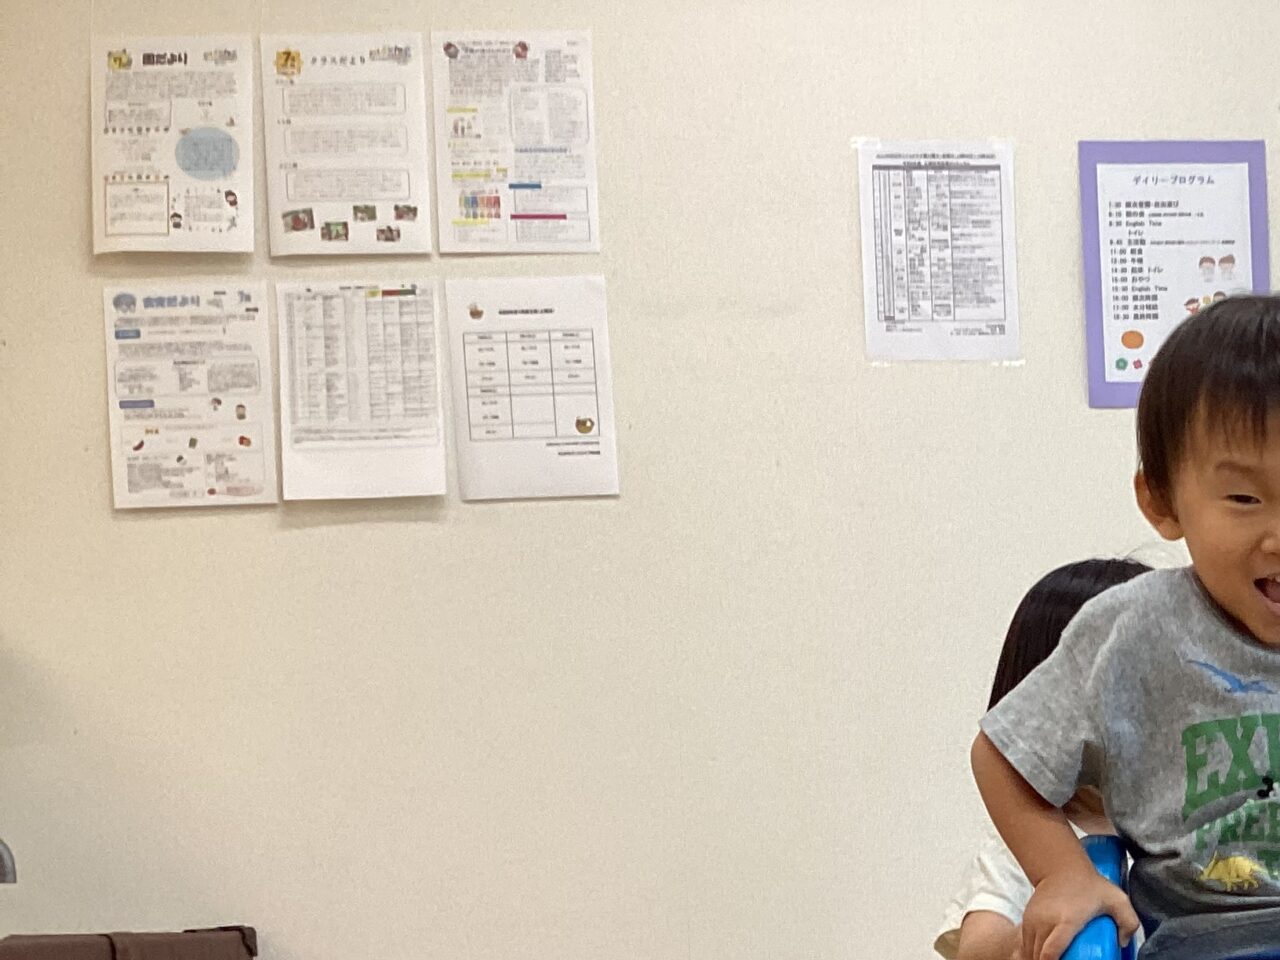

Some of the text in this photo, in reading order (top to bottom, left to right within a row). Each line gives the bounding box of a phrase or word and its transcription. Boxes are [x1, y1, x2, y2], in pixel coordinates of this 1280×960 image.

[1132, 175, 1215, 185] デイリープログラム
